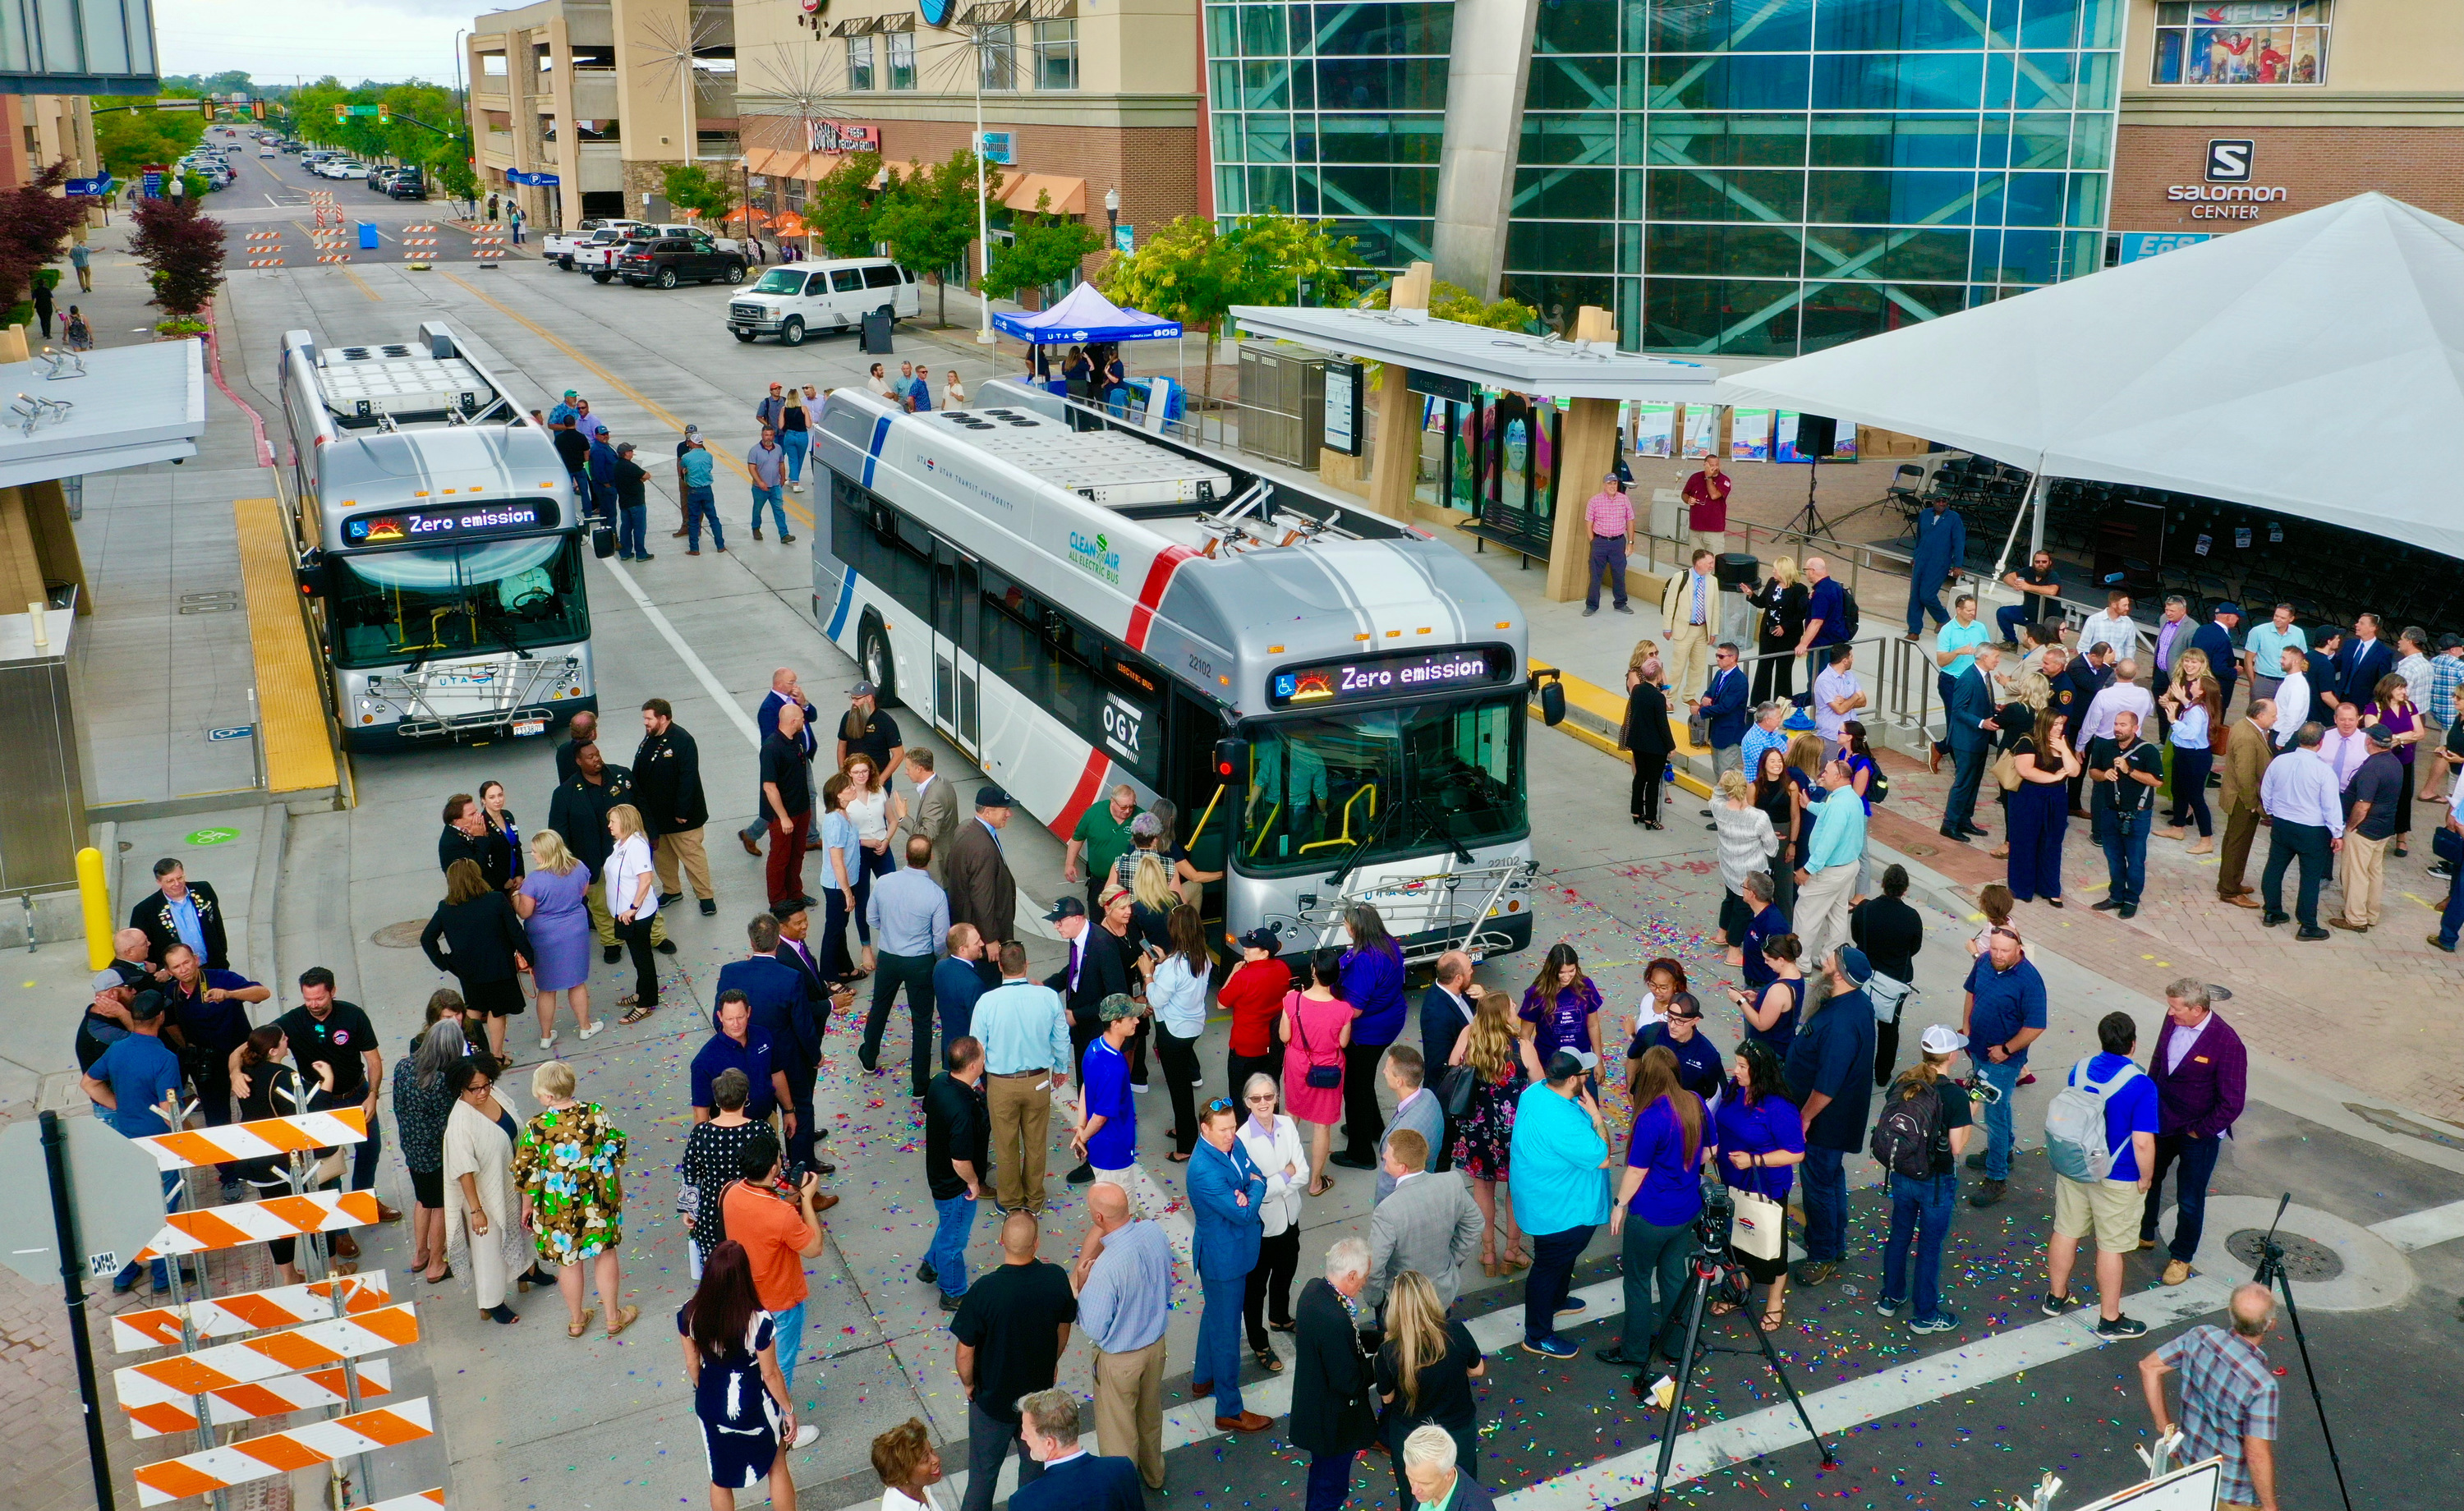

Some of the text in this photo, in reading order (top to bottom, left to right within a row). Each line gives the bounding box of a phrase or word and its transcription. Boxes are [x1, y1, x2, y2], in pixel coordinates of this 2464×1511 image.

[839, 139, 858, 150] MEXICAN
[847, 126, 864, 139] FRESH
[976, 142, 1008, 153] FOWRIDER
[2212, 145, 2248, 177] S
[2191, 204, 2259, 219] CENTER
[917, 454, 1014, 512] UTA UTAH TRANSIT AUTHORITY
[409, 507, 535, 533] Zero emission
[1069, 530, 1119, 572] CLEAN AIR
[1069, 550, 1119, 586] ALL ELECTRIC BUS
[1188, 654, 1211, 679] 22102
[1341, 655, 1484, 691] Zero emission
[439, 677, 468, 687] UTA
[1103, 705, 1139, 751] OGX
[1487, 856, 1519, 868] 22102
